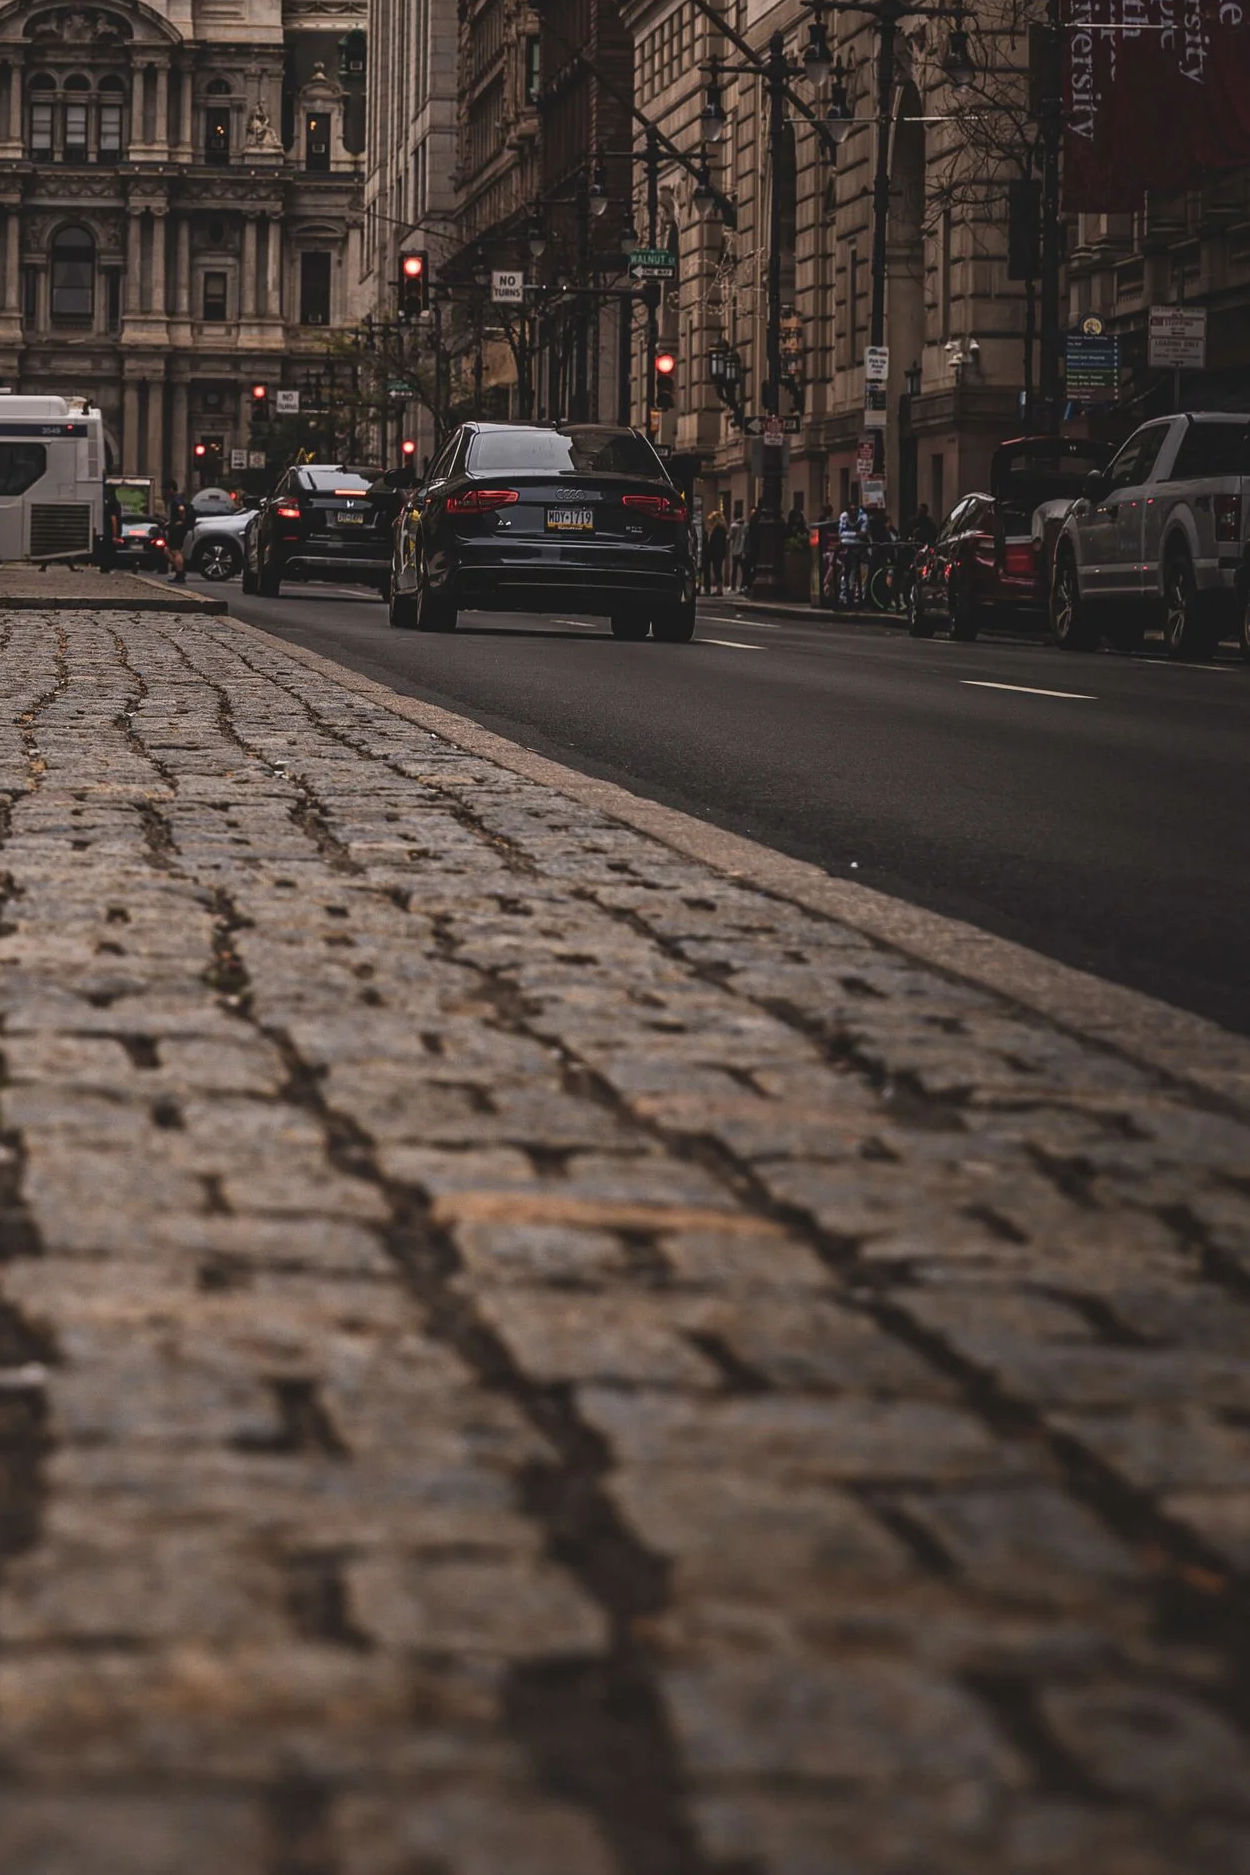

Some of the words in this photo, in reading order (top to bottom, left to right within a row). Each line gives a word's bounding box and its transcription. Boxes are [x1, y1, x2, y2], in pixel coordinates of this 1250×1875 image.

[630, 254, 665, 265] WALNUT
[500, 275, 516, 286] NO
[494, 288, 521, 297] TURNS
[282, 393, 294, 401] NO
